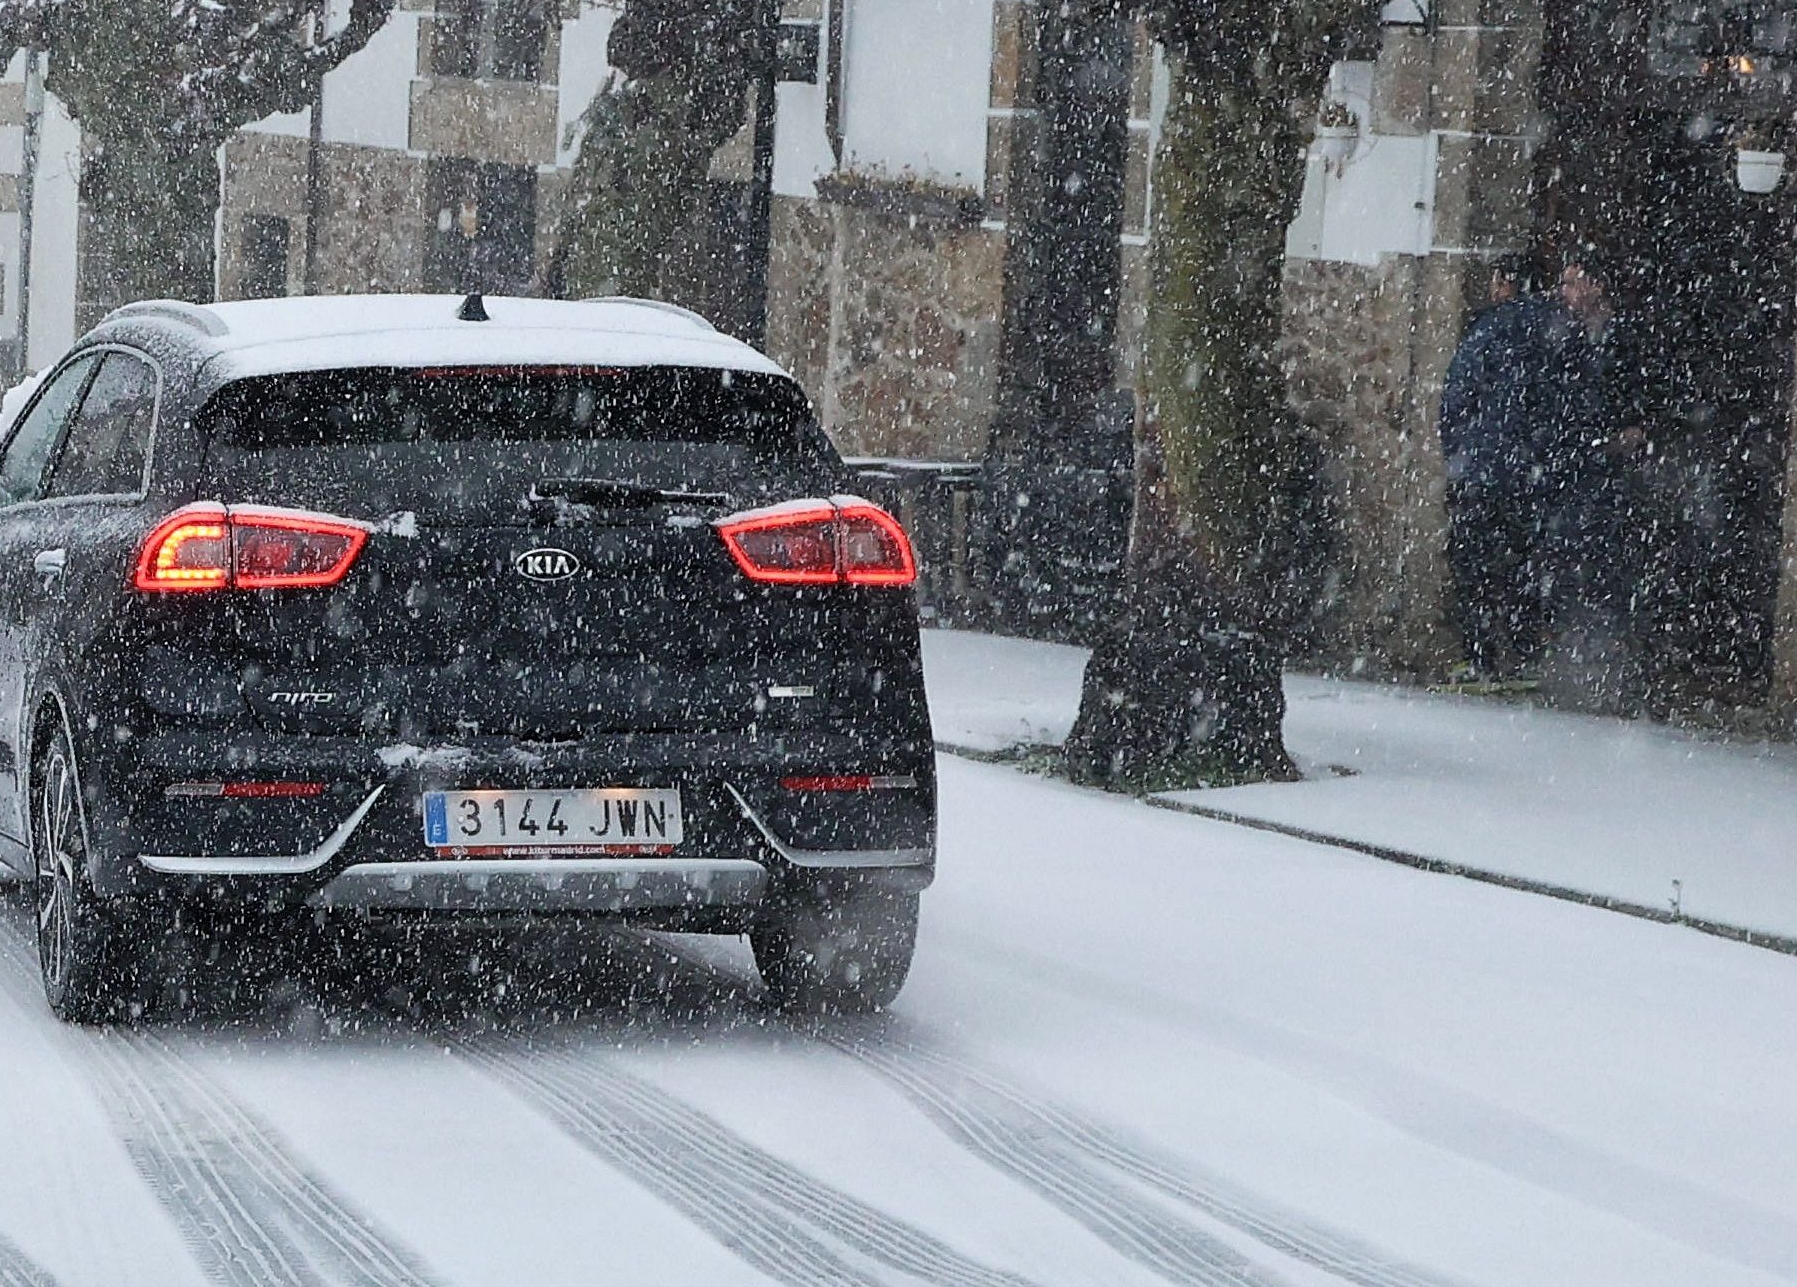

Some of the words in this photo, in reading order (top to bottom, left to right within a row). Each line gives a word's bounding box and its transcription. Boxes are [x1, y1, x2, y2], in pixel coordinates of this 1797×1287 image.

[527, 555, 570, 574] KIA
[459, 797, 569, 837] 3144
[588, 798, 666, 838] JWN
[432, 822, 442, 836] E
